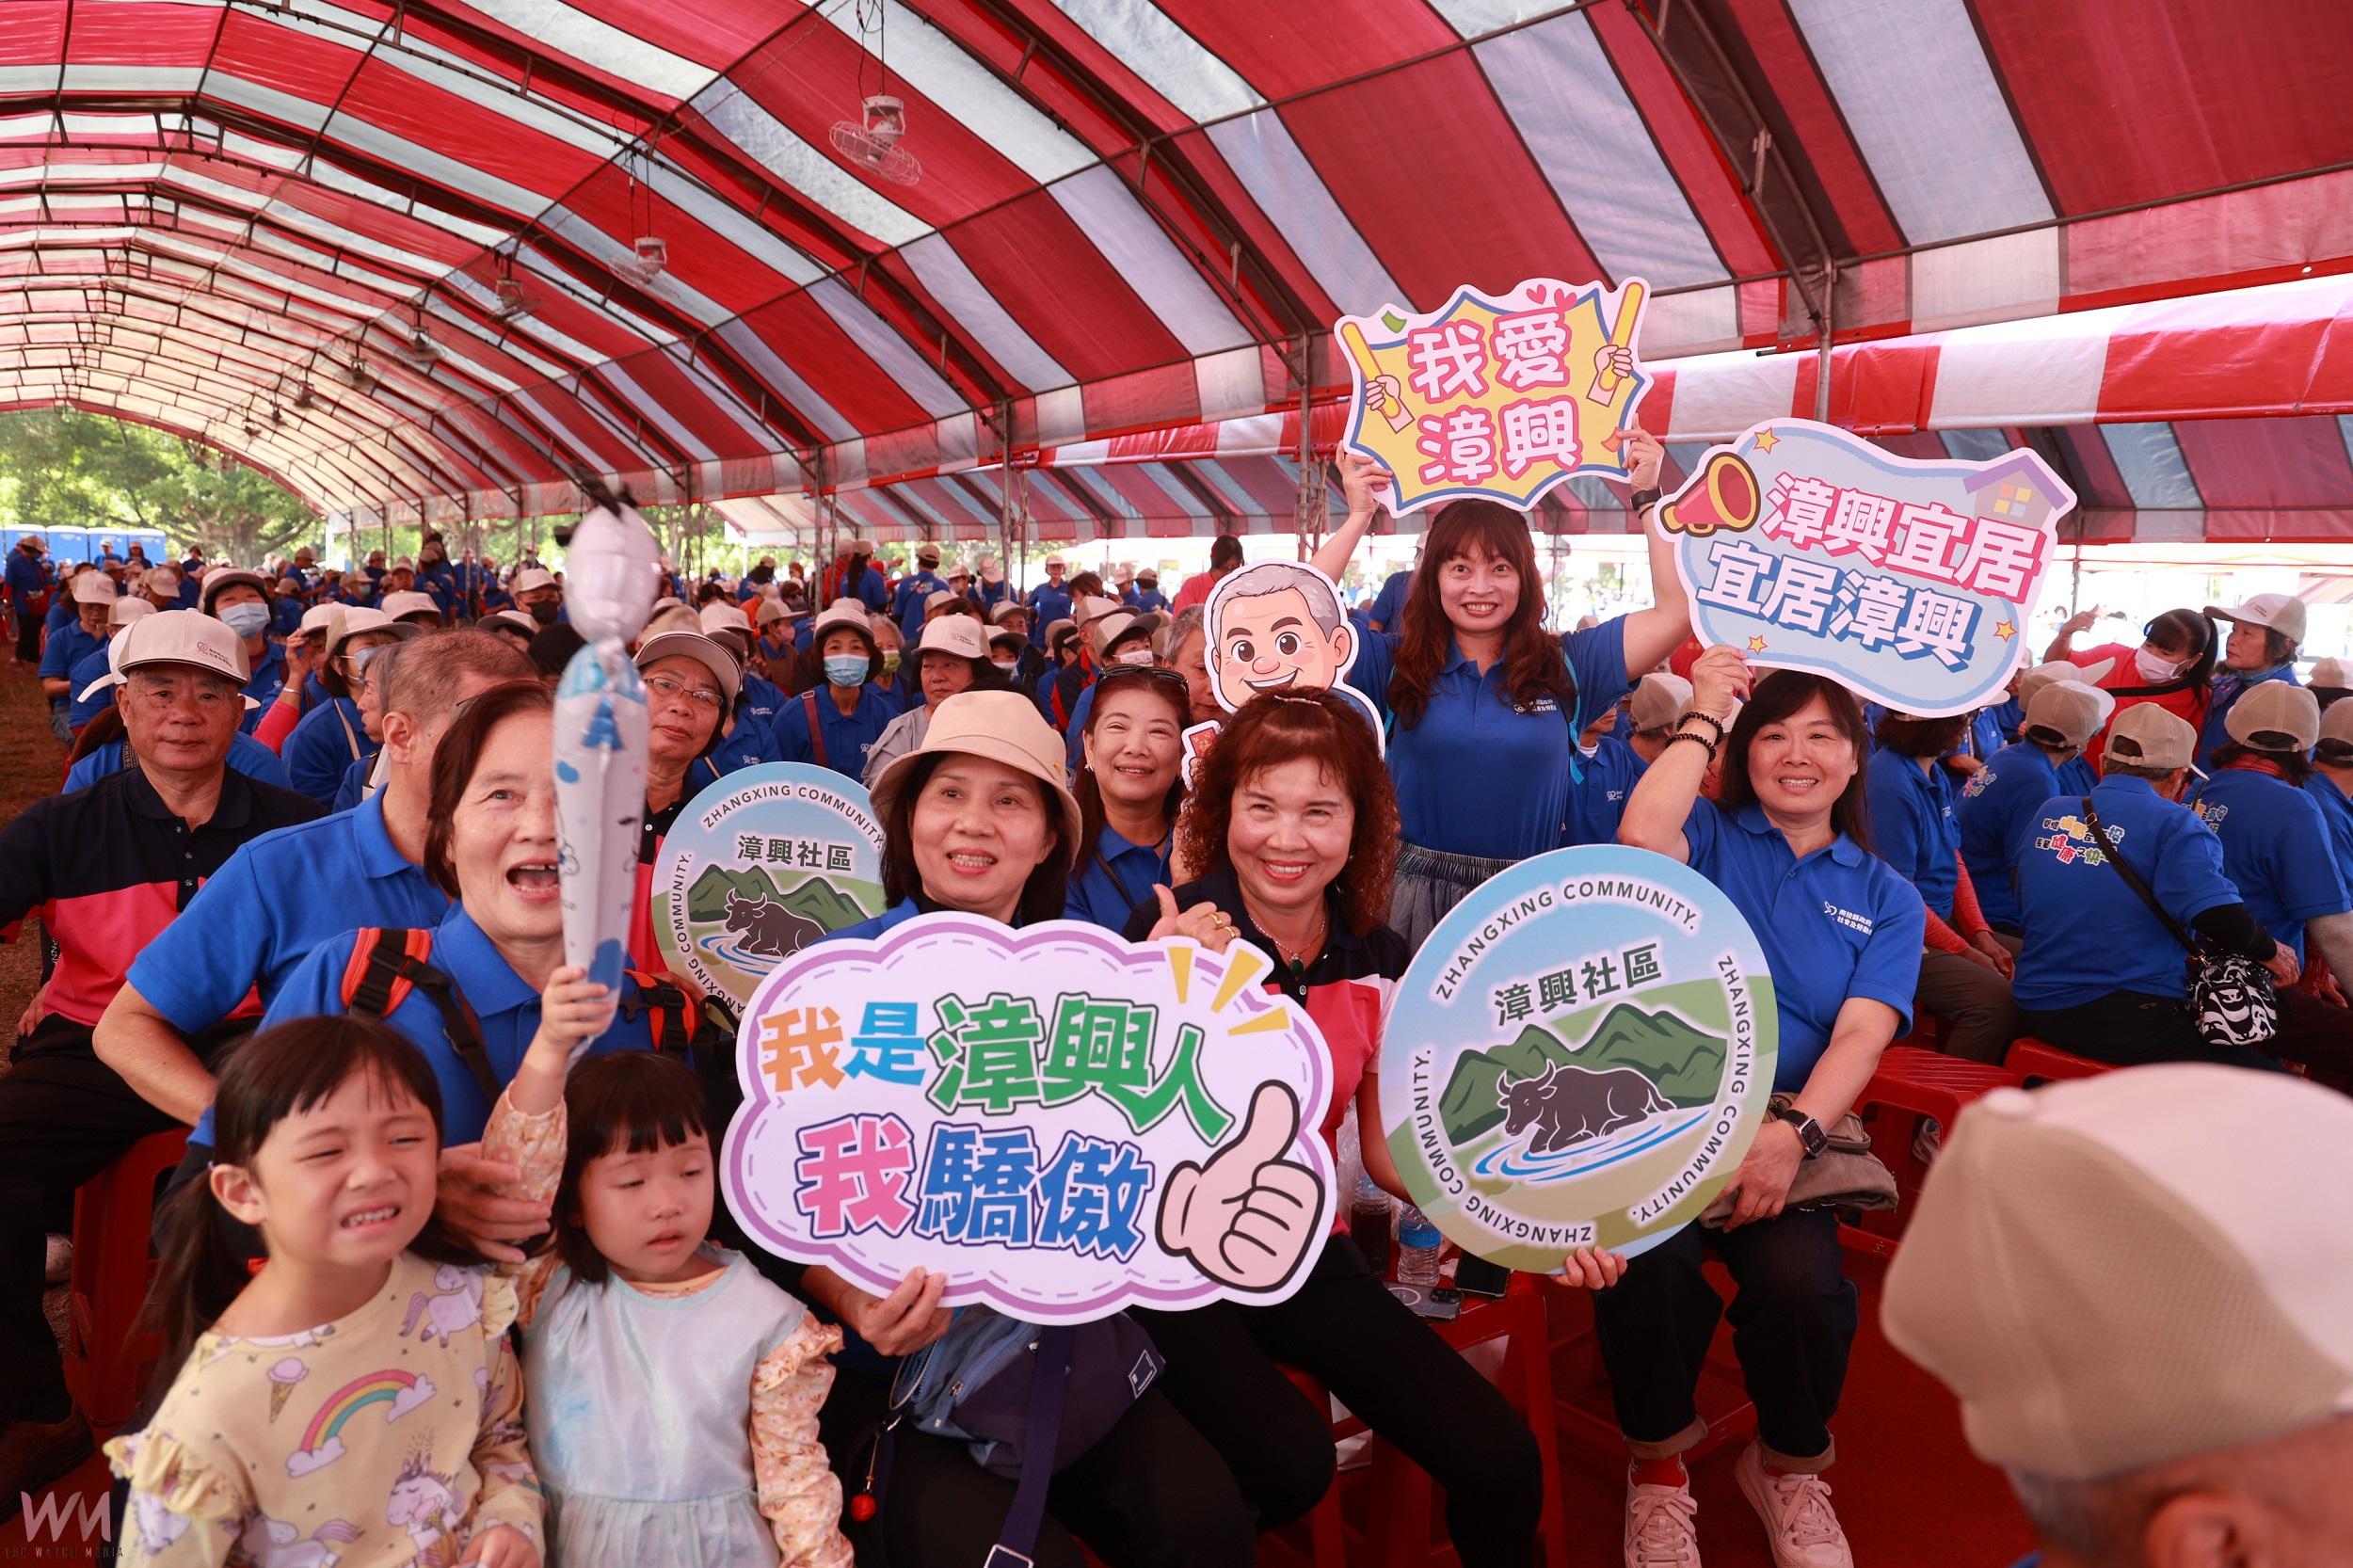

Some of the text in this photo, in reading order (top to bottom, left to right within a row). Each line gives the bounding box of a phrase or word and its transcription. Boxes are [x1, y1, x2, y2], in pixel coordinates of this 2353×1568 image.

[1410, 310, 1570, 402] 我愛
[1418, 398, 1581, 484] 漳興
[1760, 472, 2046, 604] 漳興宜居
[1696, 541, 1982, 672] 宜居漳興
[703, 785, 791, 828] ZHANGXING
[737, 835, 853, 872] 漳興社區
[671, 853, 745, 1014] ANGXING COMMUNITY.
[1436, 880, 1697, 1000] ZHANGXING COMMUNITY.
[1494, 943, 1662, 1026] 漳興社區
[760, 993, 1234, 1145] 我是漳興人
[1631, 955, 1751, 1222] ZHANGXING COMMUNITY.
[796, 1114, 1153, 1261] 我驕傲
[1413, 1048, 1592, 1242] ZHANGXING COMMUNITY.
